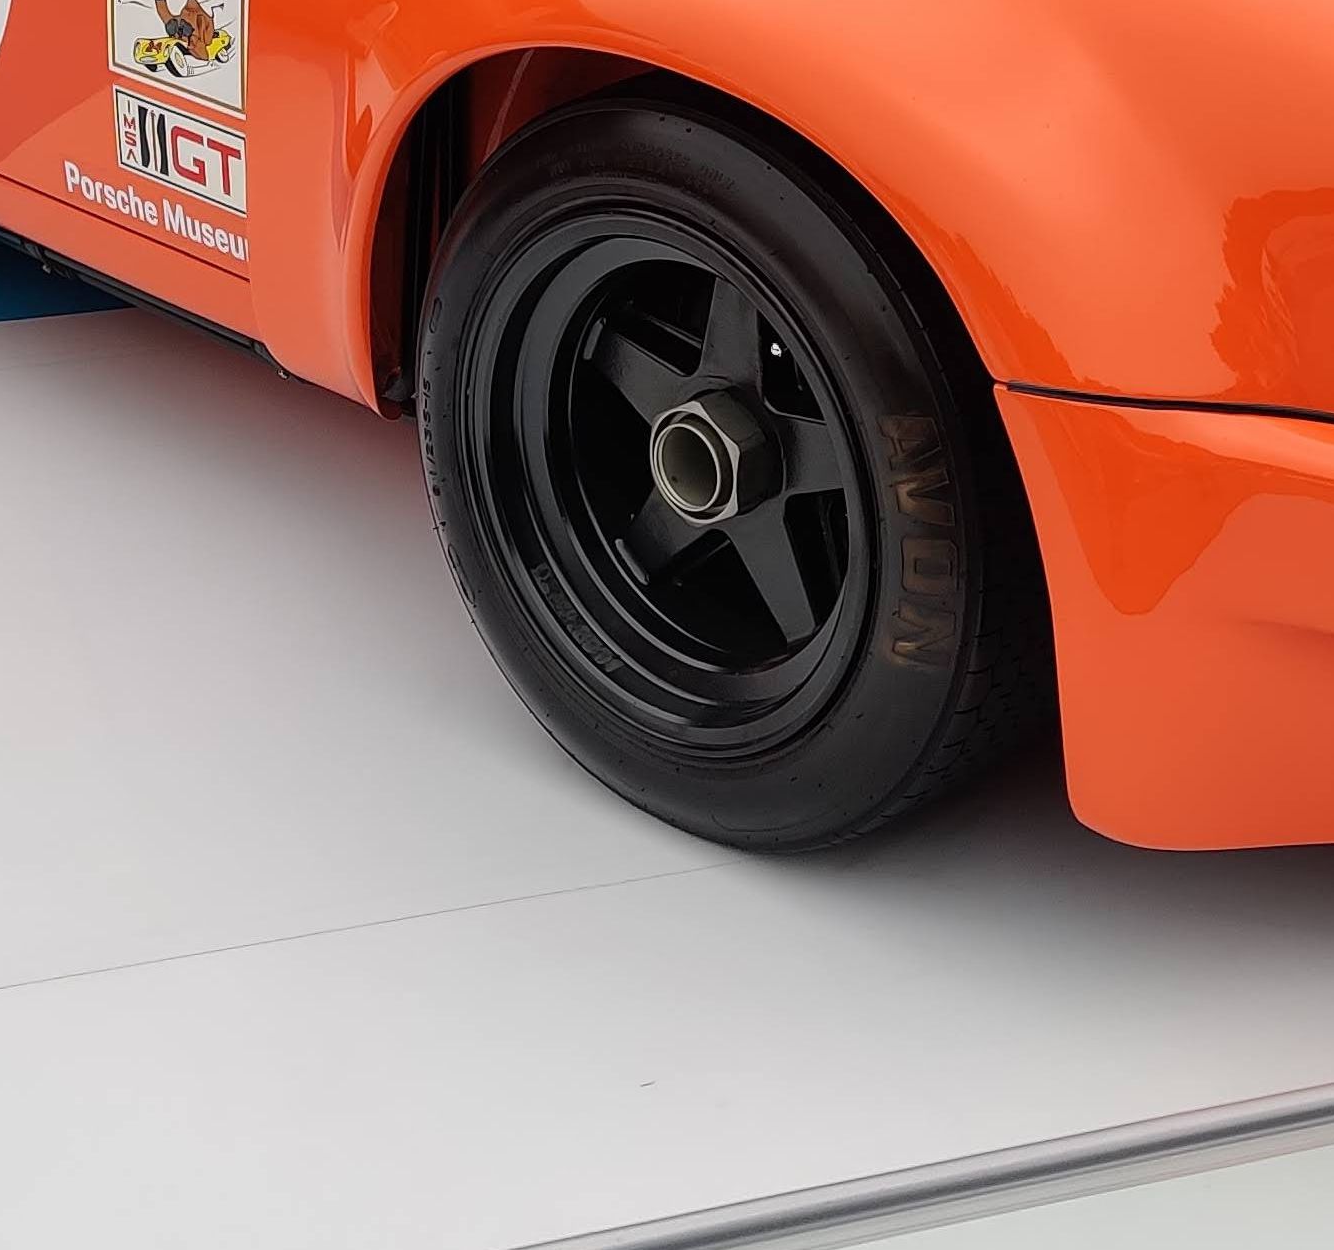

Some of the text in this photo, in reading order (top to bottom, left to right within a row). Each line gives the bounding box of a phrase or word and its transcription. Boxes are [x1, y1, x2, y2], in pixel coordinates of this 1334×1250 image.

[64, 160, 249, 262] Porsche Museu
[171, 125, 242, 197] GT
[876, 413, 960, 669] AVON
